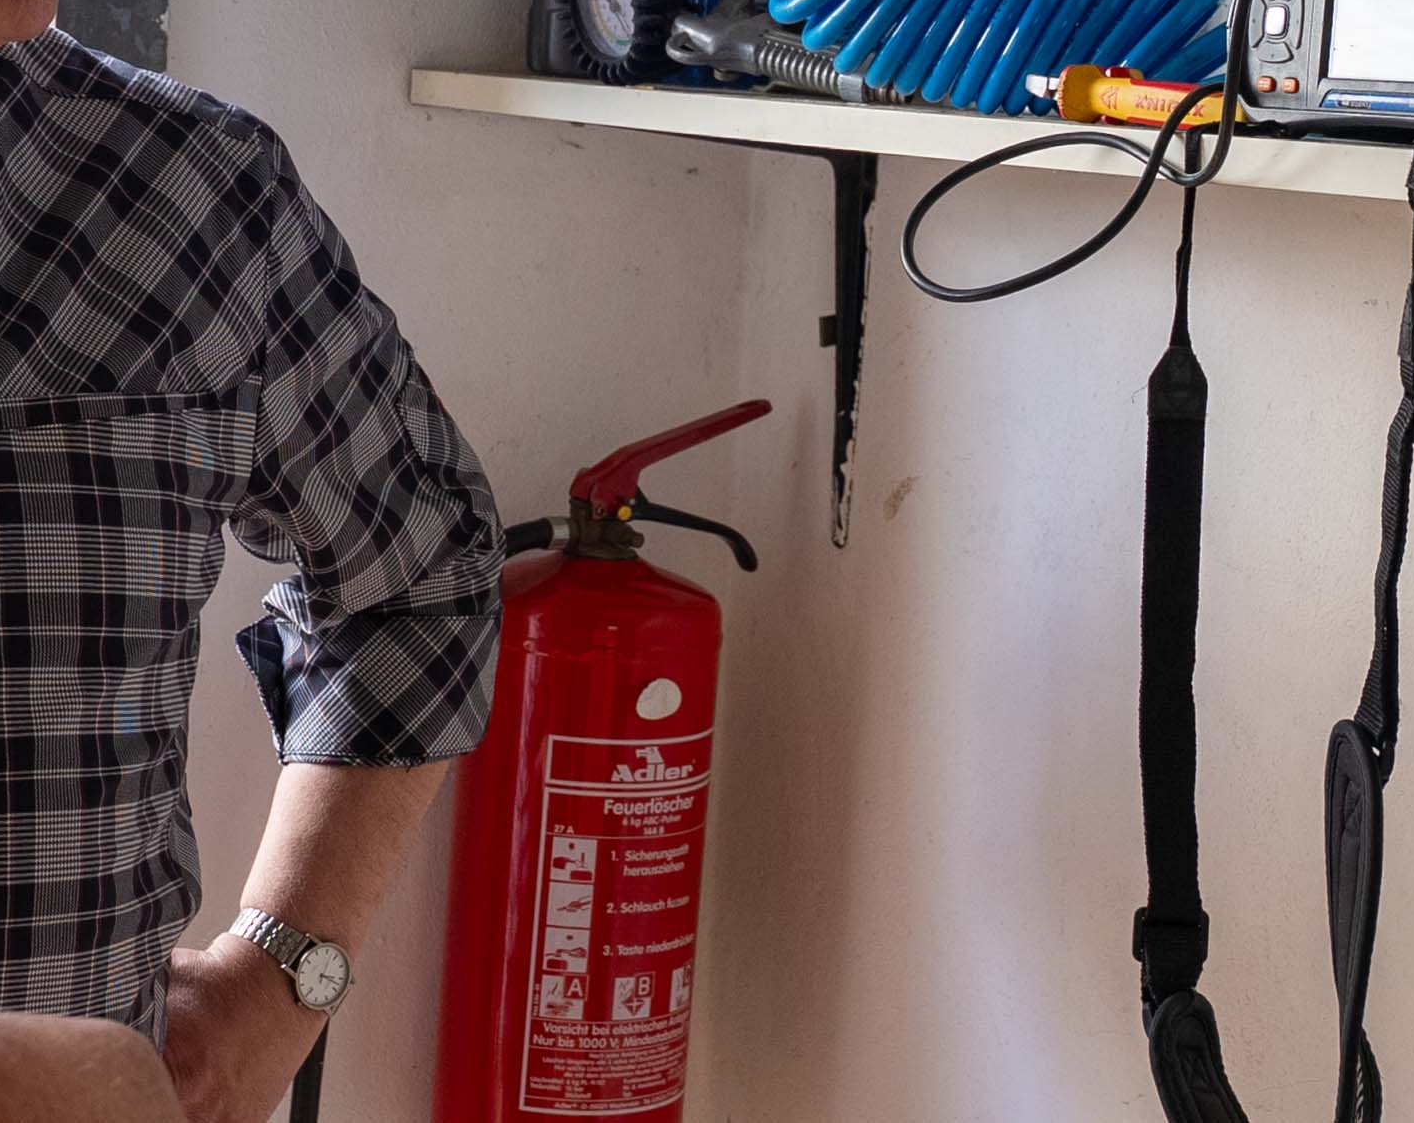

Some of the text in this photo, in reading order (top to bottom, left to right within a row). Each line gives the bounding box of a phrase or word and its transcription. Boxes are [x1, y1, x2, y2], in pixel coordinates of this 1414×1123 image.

[1135, 94, 1205, 117] KNIPX
[611, 763, 694, 782] Adler
[603, 796, 695, 815] Feuerlöscher
[554, 824, 575, 834] 27 A
[630, 817, 640, 828] kg
[611, 850, 619, 862] 1.
[606, 899, 665, 914] 2. Schlauch
[603, 944, 643, 956] 3. Taste
[567, 978, 583, 997] A
[638, 977, 651, 996] B
[543, 1022, 589, 1036] Vorsicht
[591, 1025, 610, 1036] bei
[533, 1035, 555, 1046] Nur
[558, 1037, 575, 1048] bis
[578, 1038, 607, 1049] 1000
